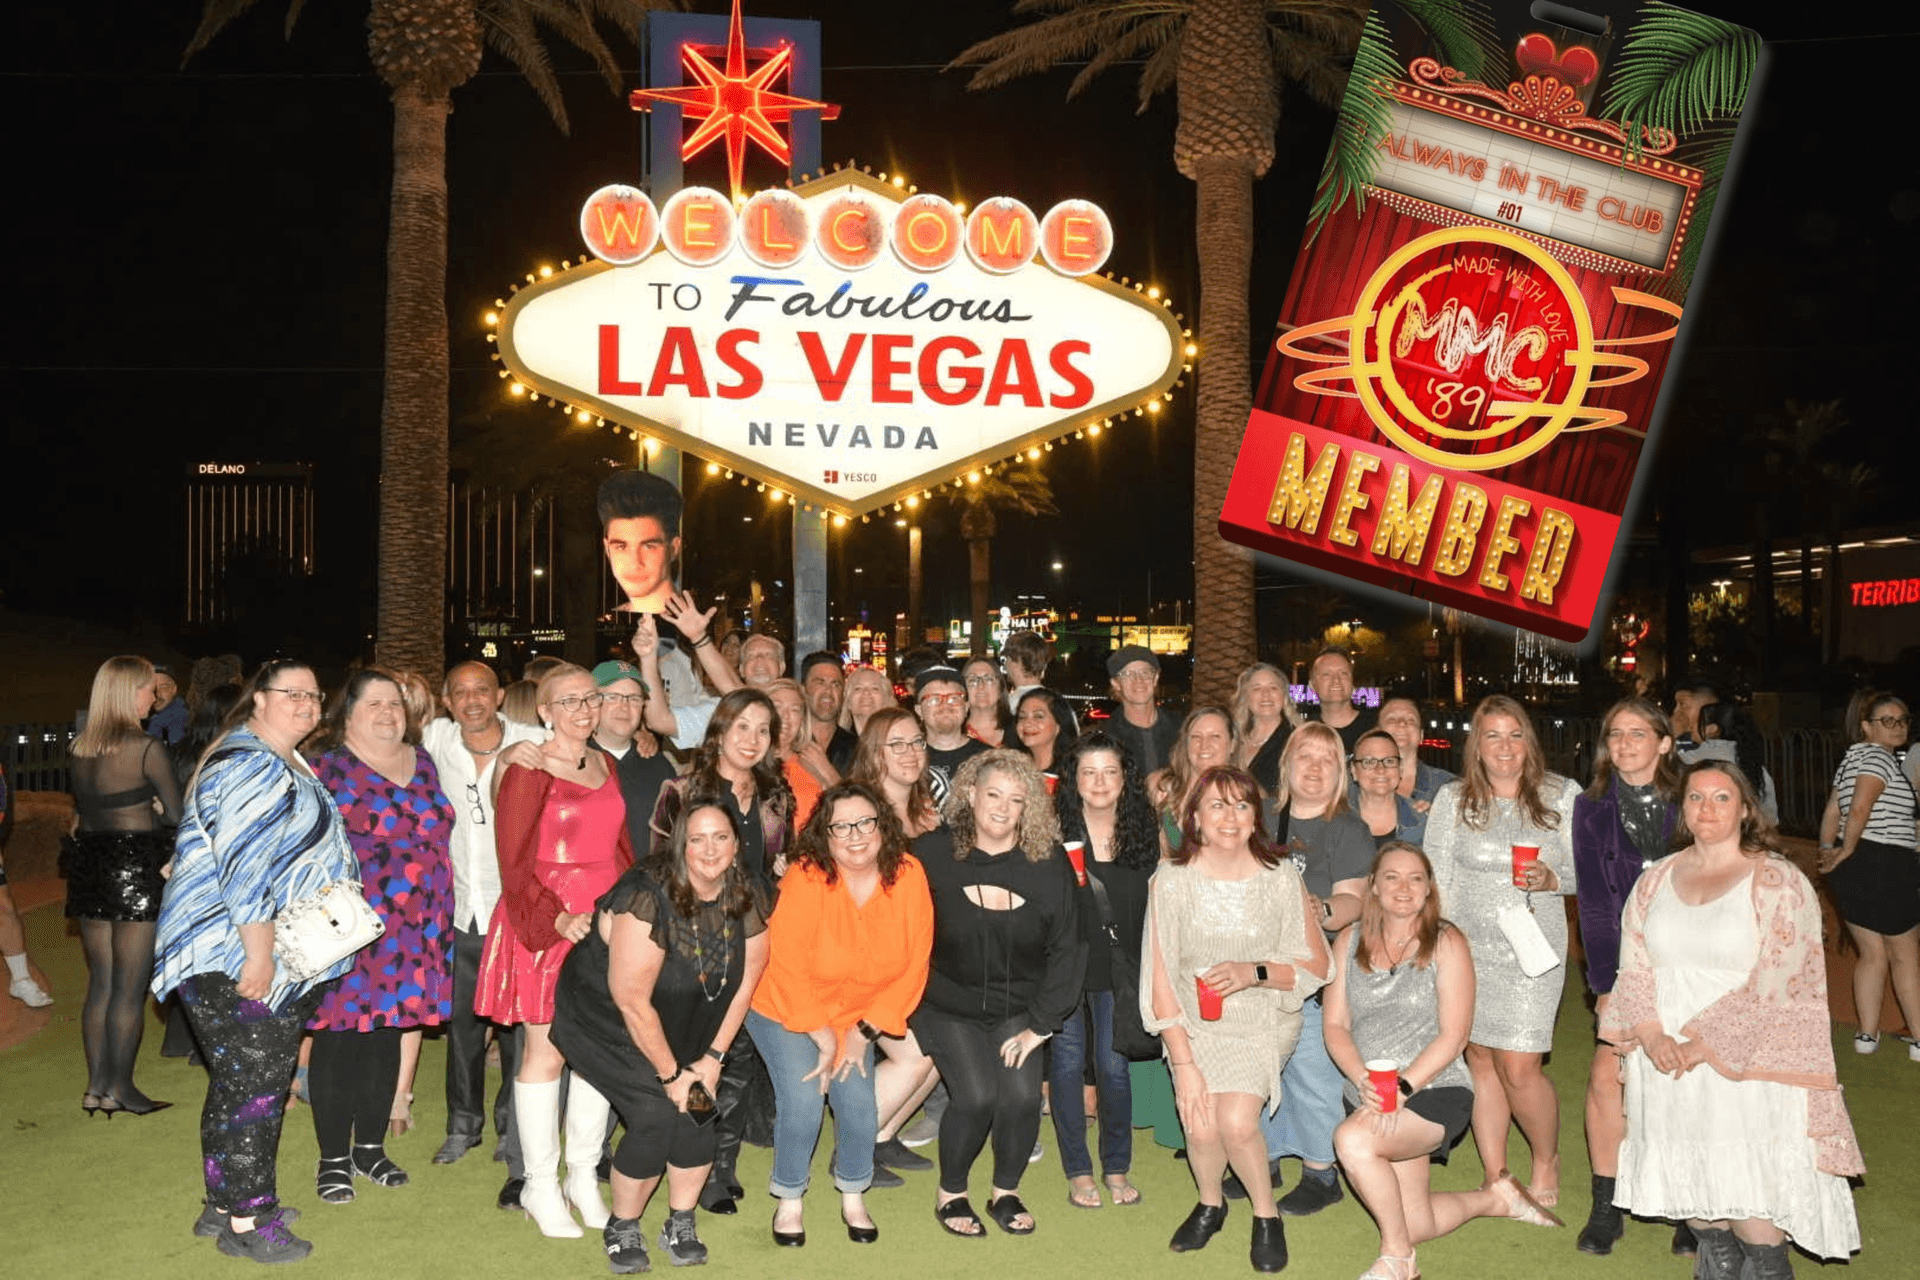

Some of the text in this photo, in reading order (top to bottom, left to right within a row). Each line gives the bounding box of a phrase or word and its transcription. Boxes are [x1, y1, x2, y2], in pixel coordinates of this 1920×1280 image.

[594, 198, 1098, 262] WELCOME
[648, 275, 1034, 323] TO Fabulous
[597, 323, 1095, 410] LAS VEGAS
[748, 421, 939, 451] NEVADA
[199, 464, 245, 474] DELANO
[843, 472, 877, 483] YESCO
[1850, 578, 1920, 607] TERRIB
